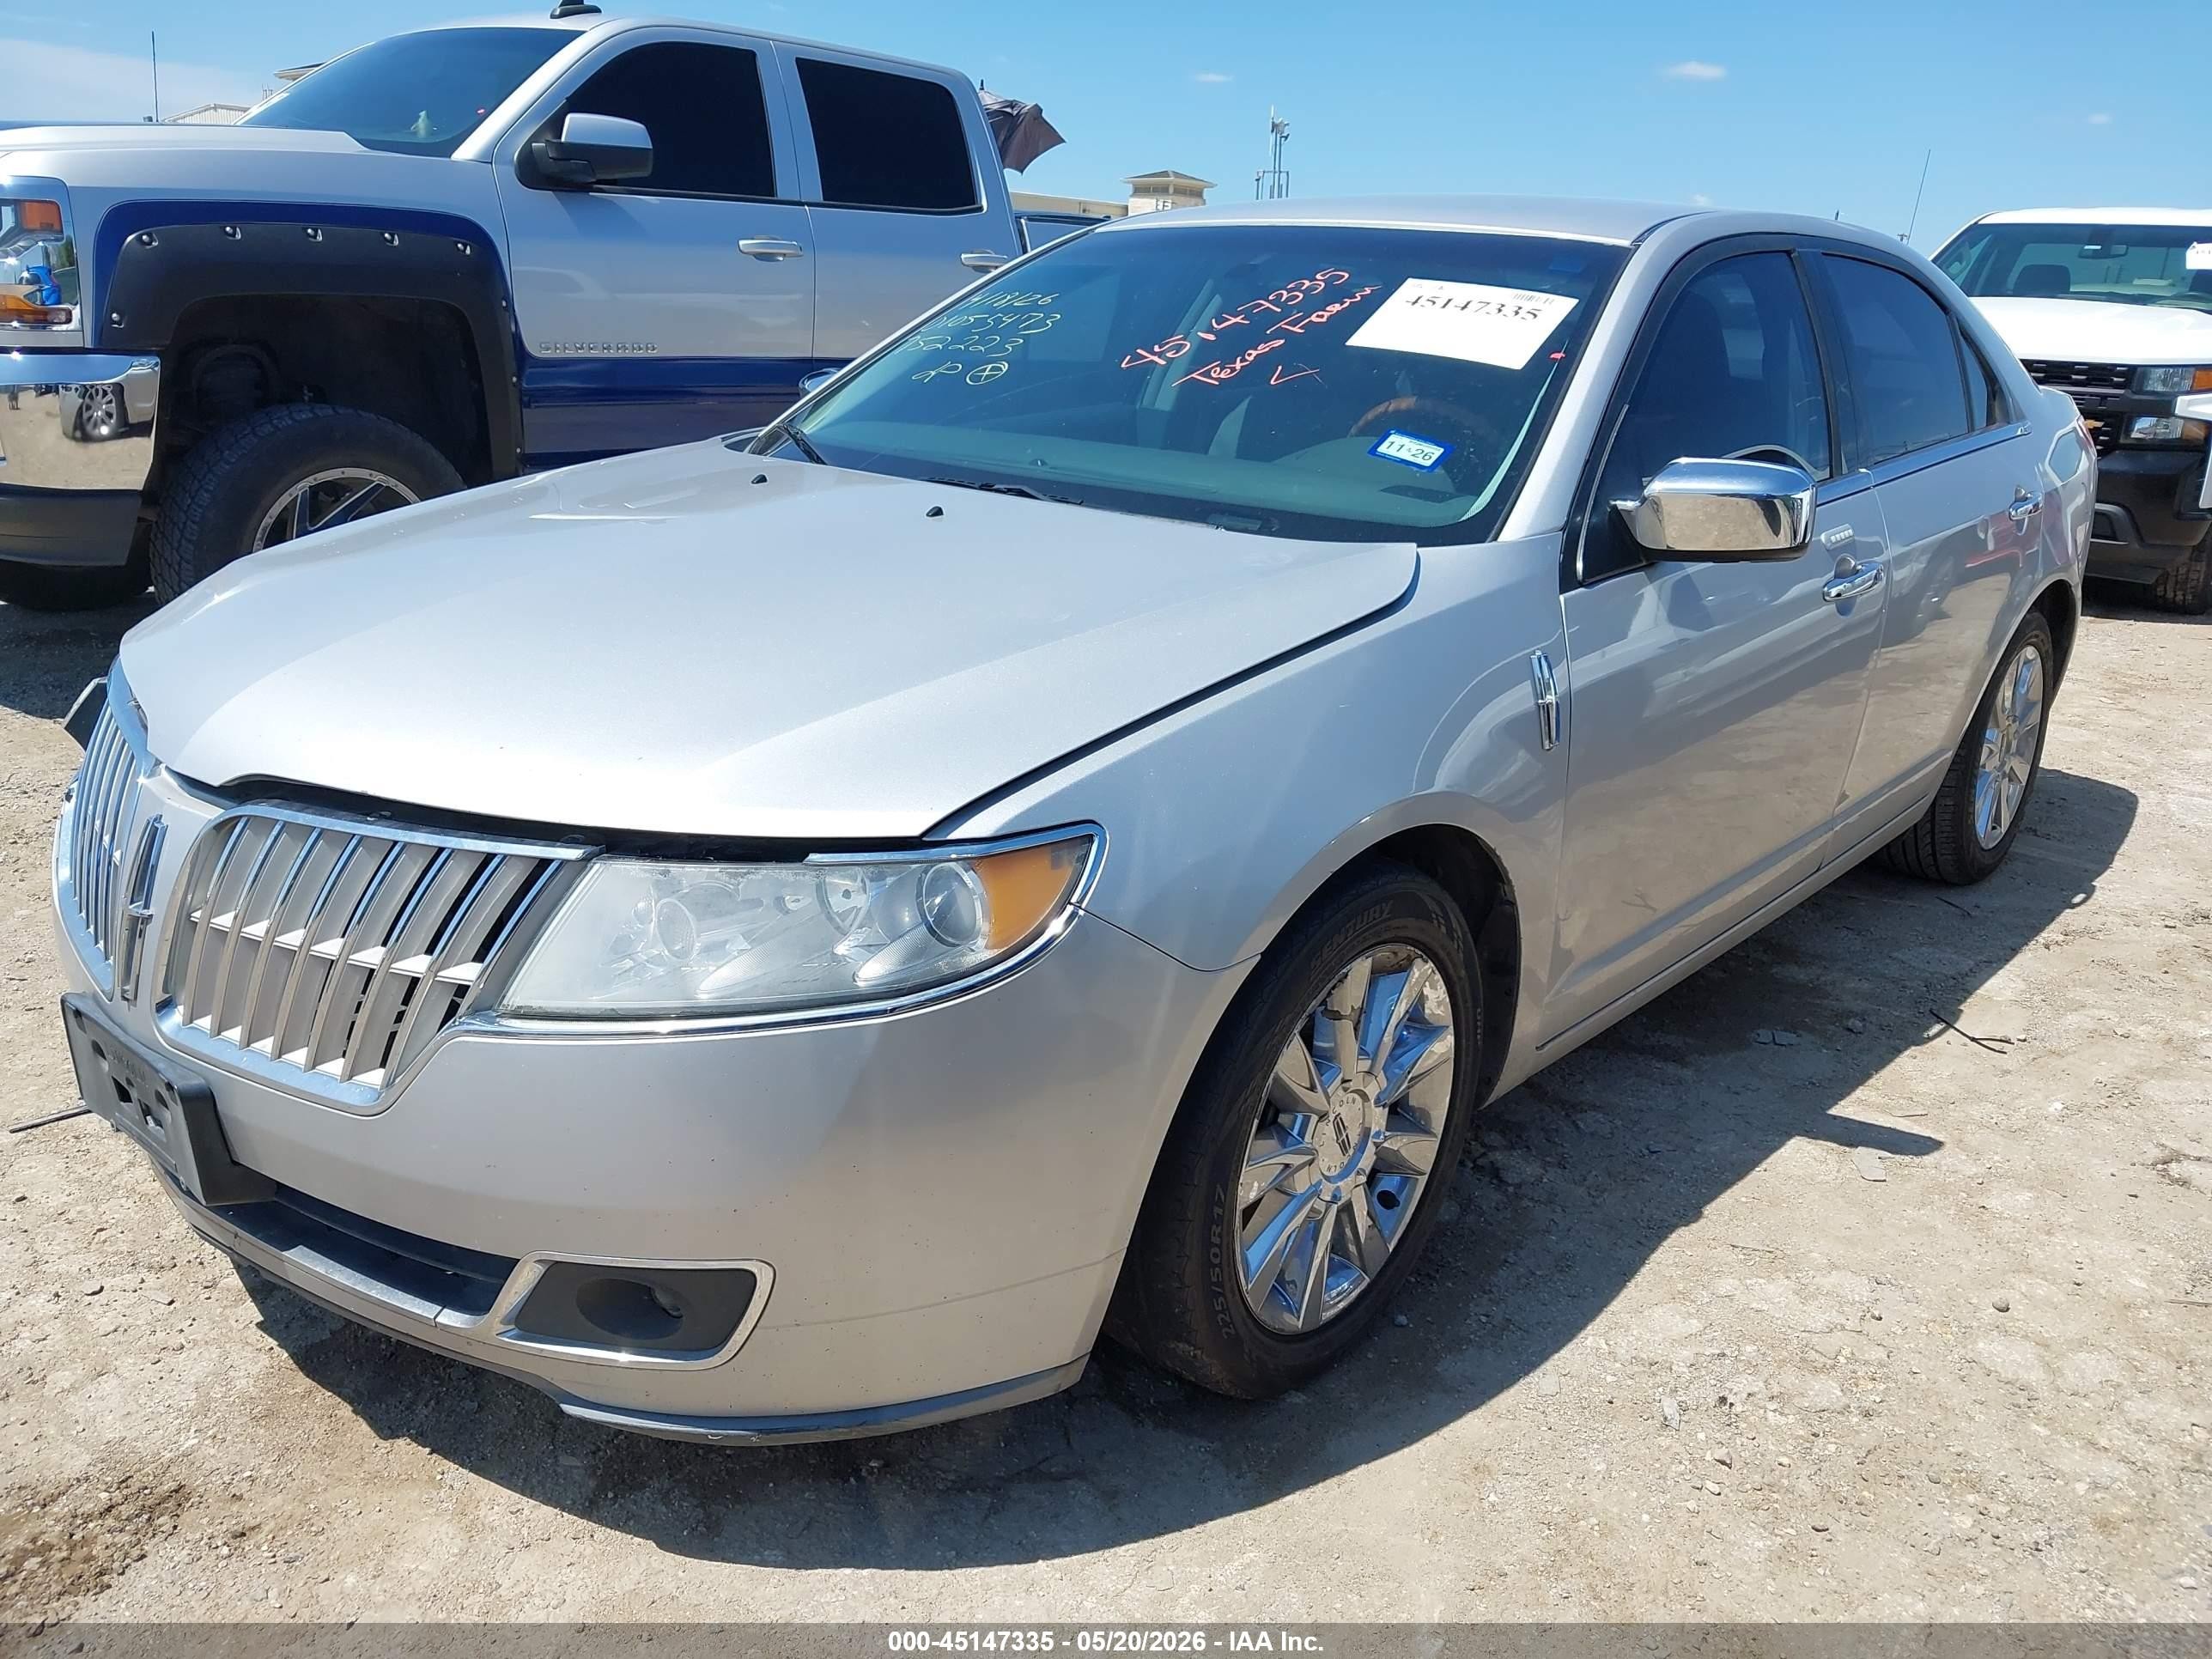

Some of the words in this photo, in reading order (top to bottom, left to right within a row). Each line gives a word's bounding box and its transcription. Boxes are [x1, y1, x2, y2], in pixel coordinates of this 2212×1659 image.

[1121, 268, 1349, 368] 45147335
[1405, 295, 1542, 320] 45147335
[539, 342, 659, 354] SILVERADO
[1209, 1184, 1237, 1340] 225/50R17
